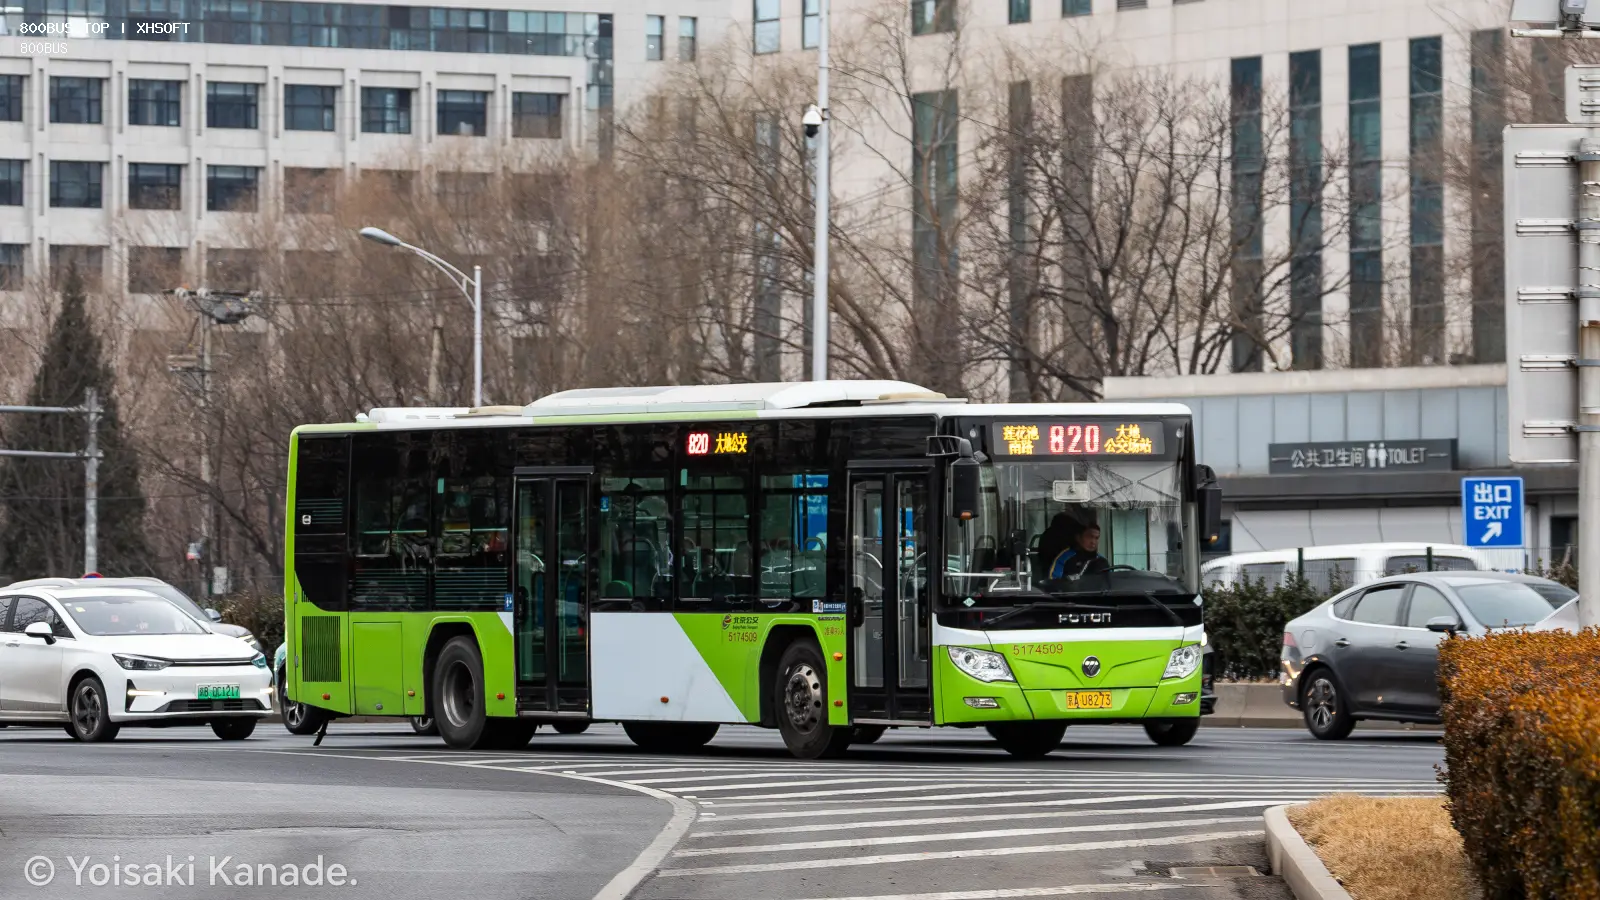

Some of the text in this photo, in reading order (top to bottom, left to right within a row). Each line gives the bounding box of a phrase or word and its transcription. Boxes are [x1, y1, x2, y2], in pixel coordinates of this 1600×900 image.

[1003, 425, 1039, 440] 莲花池
[1115, 424, 1140, 439] 大地
[688, 432, 748, 454] 820 大地公交
[1050, 425, 1100, 454] 820
[1104, 438, 1152, 454] 公交场站
[1009, 440, 1034, 455] 南路
[1291, 447, 1427, 468] 公共卫生间 TOILET
[1473, 482, 1512, 503] 出口
[1474, 506, 1512, 520] EXIT
[733, 616, 759, 624] 北京公交
[1058, 613, 1112, 624] FOTON
[728, 632, 757, 642] 5174509
[1013, 643, 1064, 655] 5174509
